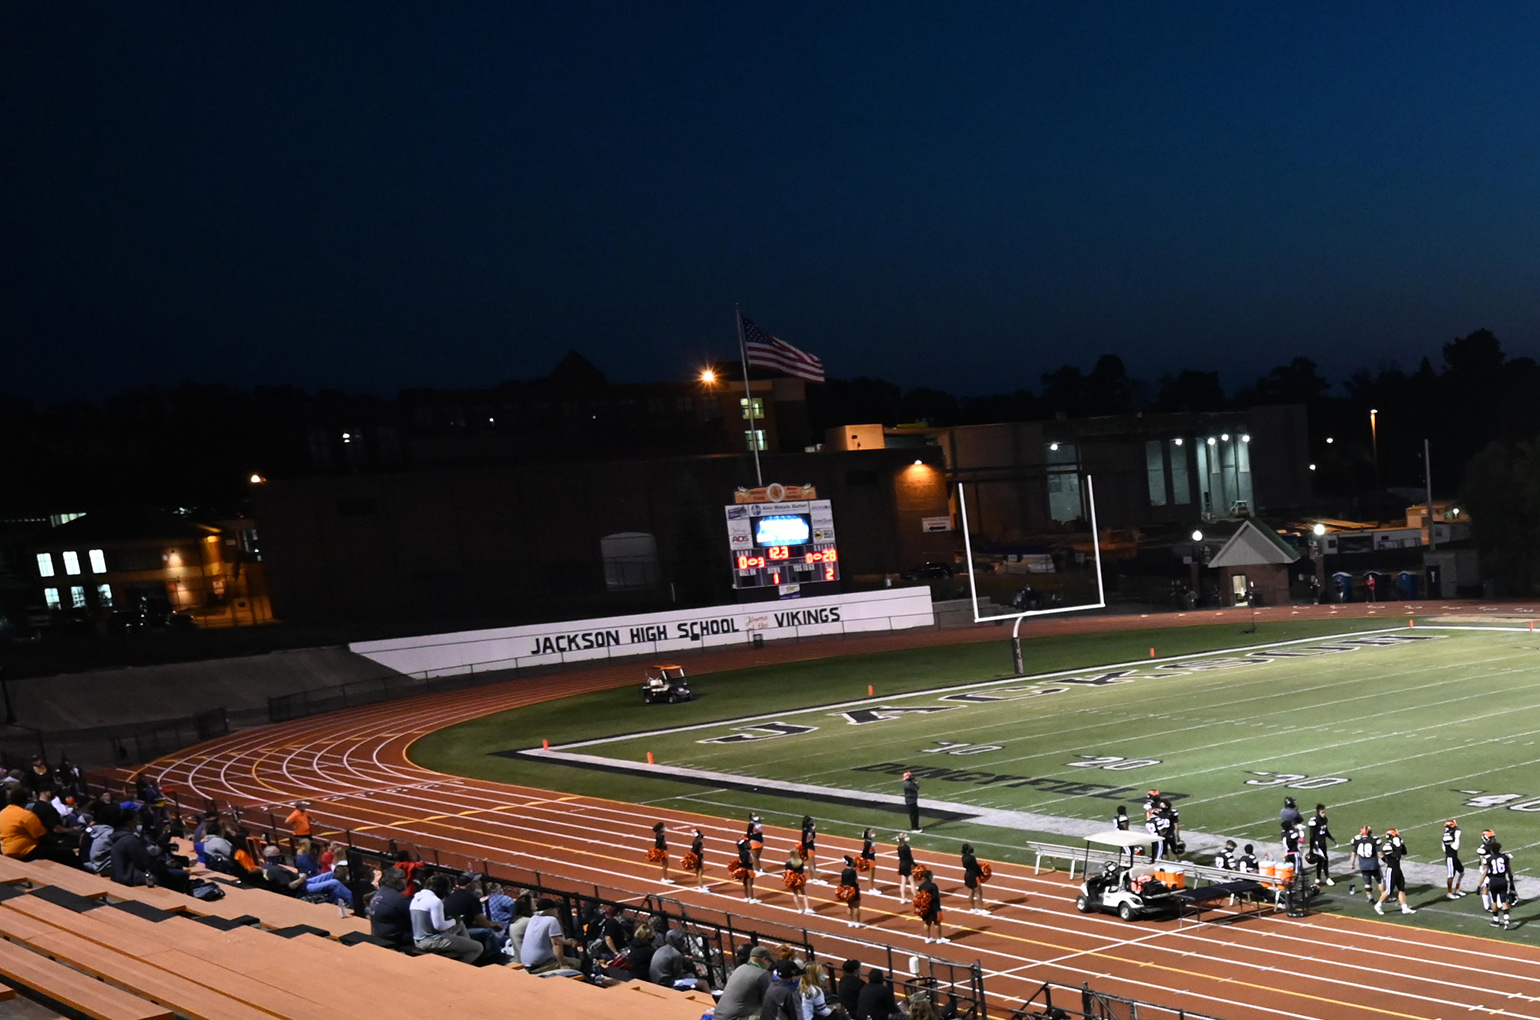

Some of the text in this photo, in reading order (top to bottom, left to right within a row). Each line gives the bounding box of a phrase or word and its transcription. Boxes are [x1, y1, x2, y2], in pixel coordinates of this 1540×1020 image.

[774, 607, 842, 628] VIKINGS
[531, 618, 740, 655] JACKSON HIGH SCHOOL
[696, 634, 1450, 744] JACKSON
[1065, 755, 1163, 771] 20
[1244, 771, 1353, 790] 30
[1490, 857, 1505, 875] 16
